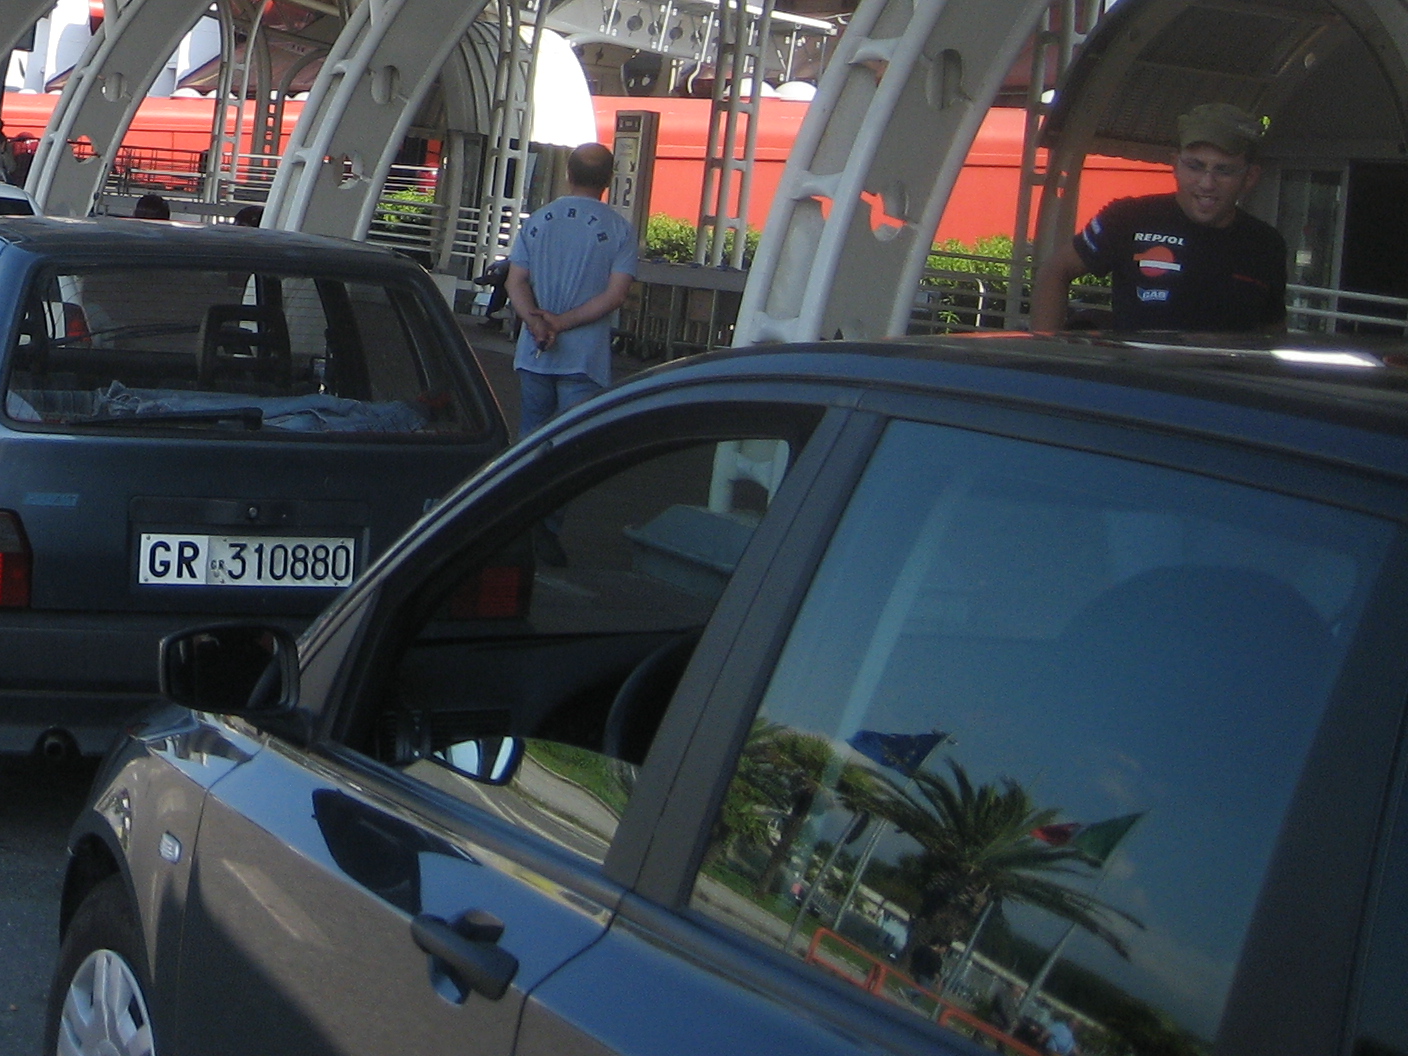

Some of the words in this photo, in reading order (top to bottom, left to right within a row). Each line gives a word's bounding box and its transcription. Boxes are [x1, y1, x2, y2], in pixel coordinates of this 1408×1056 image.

[530, 208, 609, 243] NORTH
[1133, 232, 1185, 246] REPSOL
[148, 540, 200, 579] GR
[227, 543, 350, 581] 310880
